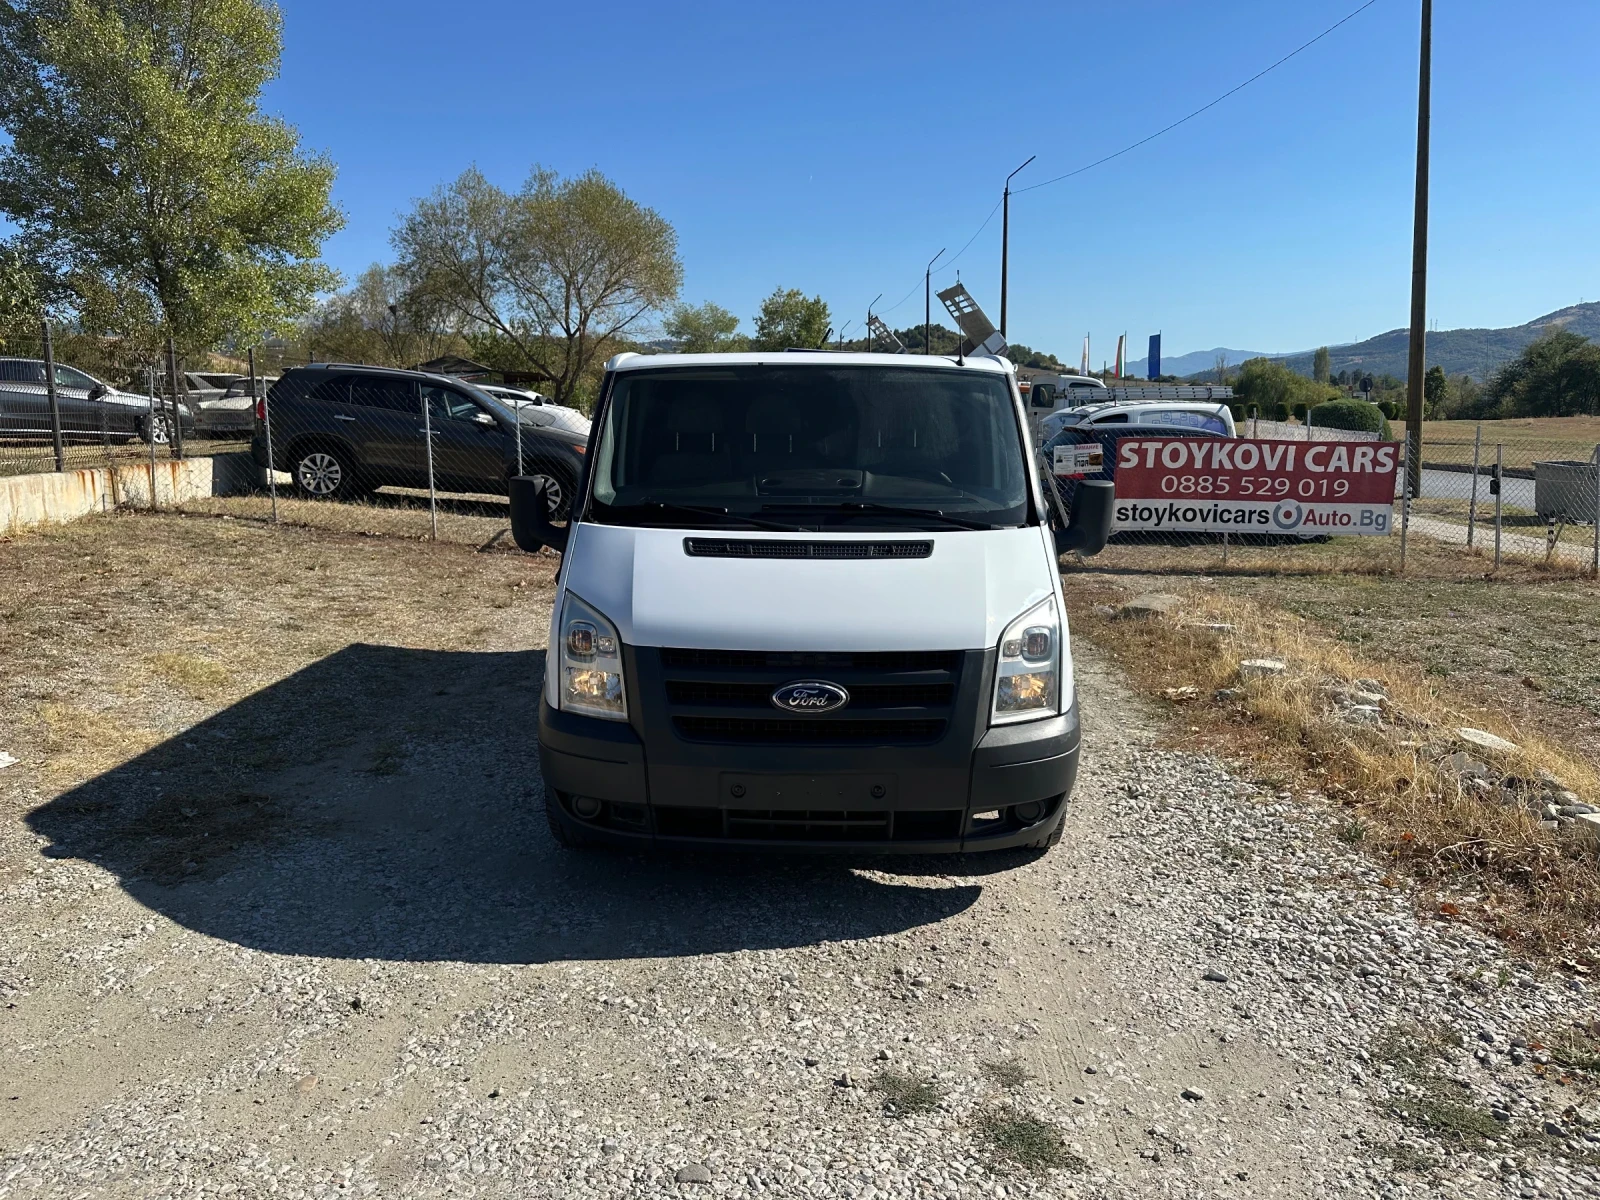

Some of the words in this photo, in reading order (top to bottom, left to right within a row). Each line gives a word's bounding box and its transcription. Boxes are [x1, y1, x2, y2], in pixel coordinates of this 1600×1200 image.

[1118, 442, 1297, 471] STOYKOVI
[1303, 445, 1395, 474] CARS
[1161, 475, 1231, 494] 0885
[1238, 476, 1291, 496] 529
[1298, 478, 1350, 497] 019
[1116, 503, 1270, 527] stoykovicars
[788, 688, 829, 706] Ford
